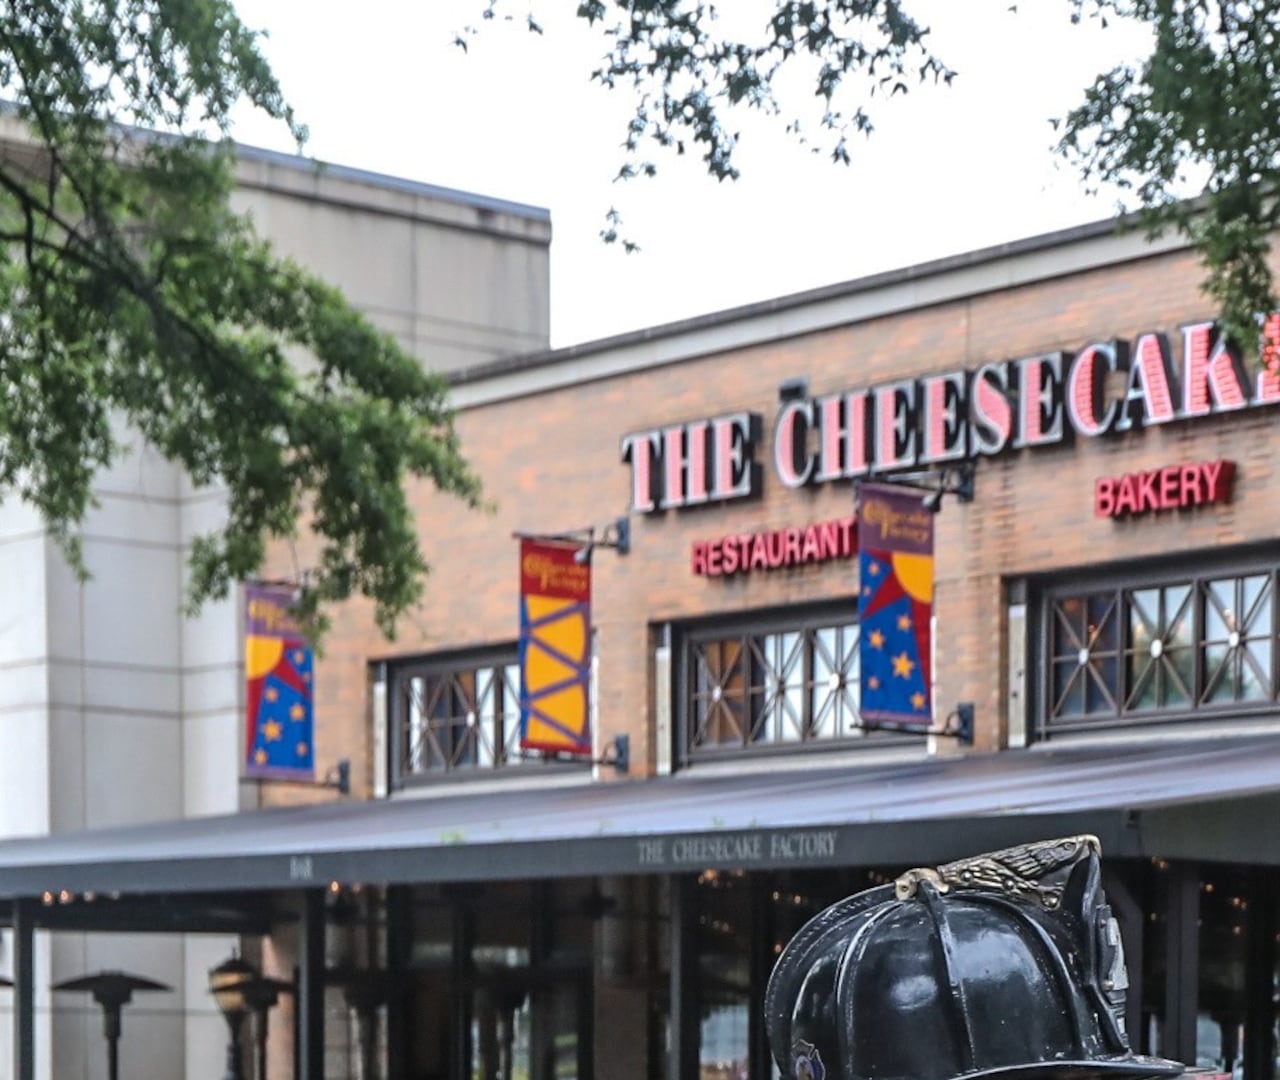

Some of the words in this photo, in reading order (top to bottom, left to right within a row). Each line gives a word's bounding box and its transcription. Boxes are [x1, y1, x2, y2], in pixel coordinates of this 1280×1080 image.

[620, 411, 764, 514] THE
[1094, 460, 1234, 518] BAKERY
[692, 518, 858, 577] RESTAURANT
[639, 839, 665, 864] THE
[672, 834, 762, 862] CHEESECAKE
[770, 830, 838, 859] FACTORY
